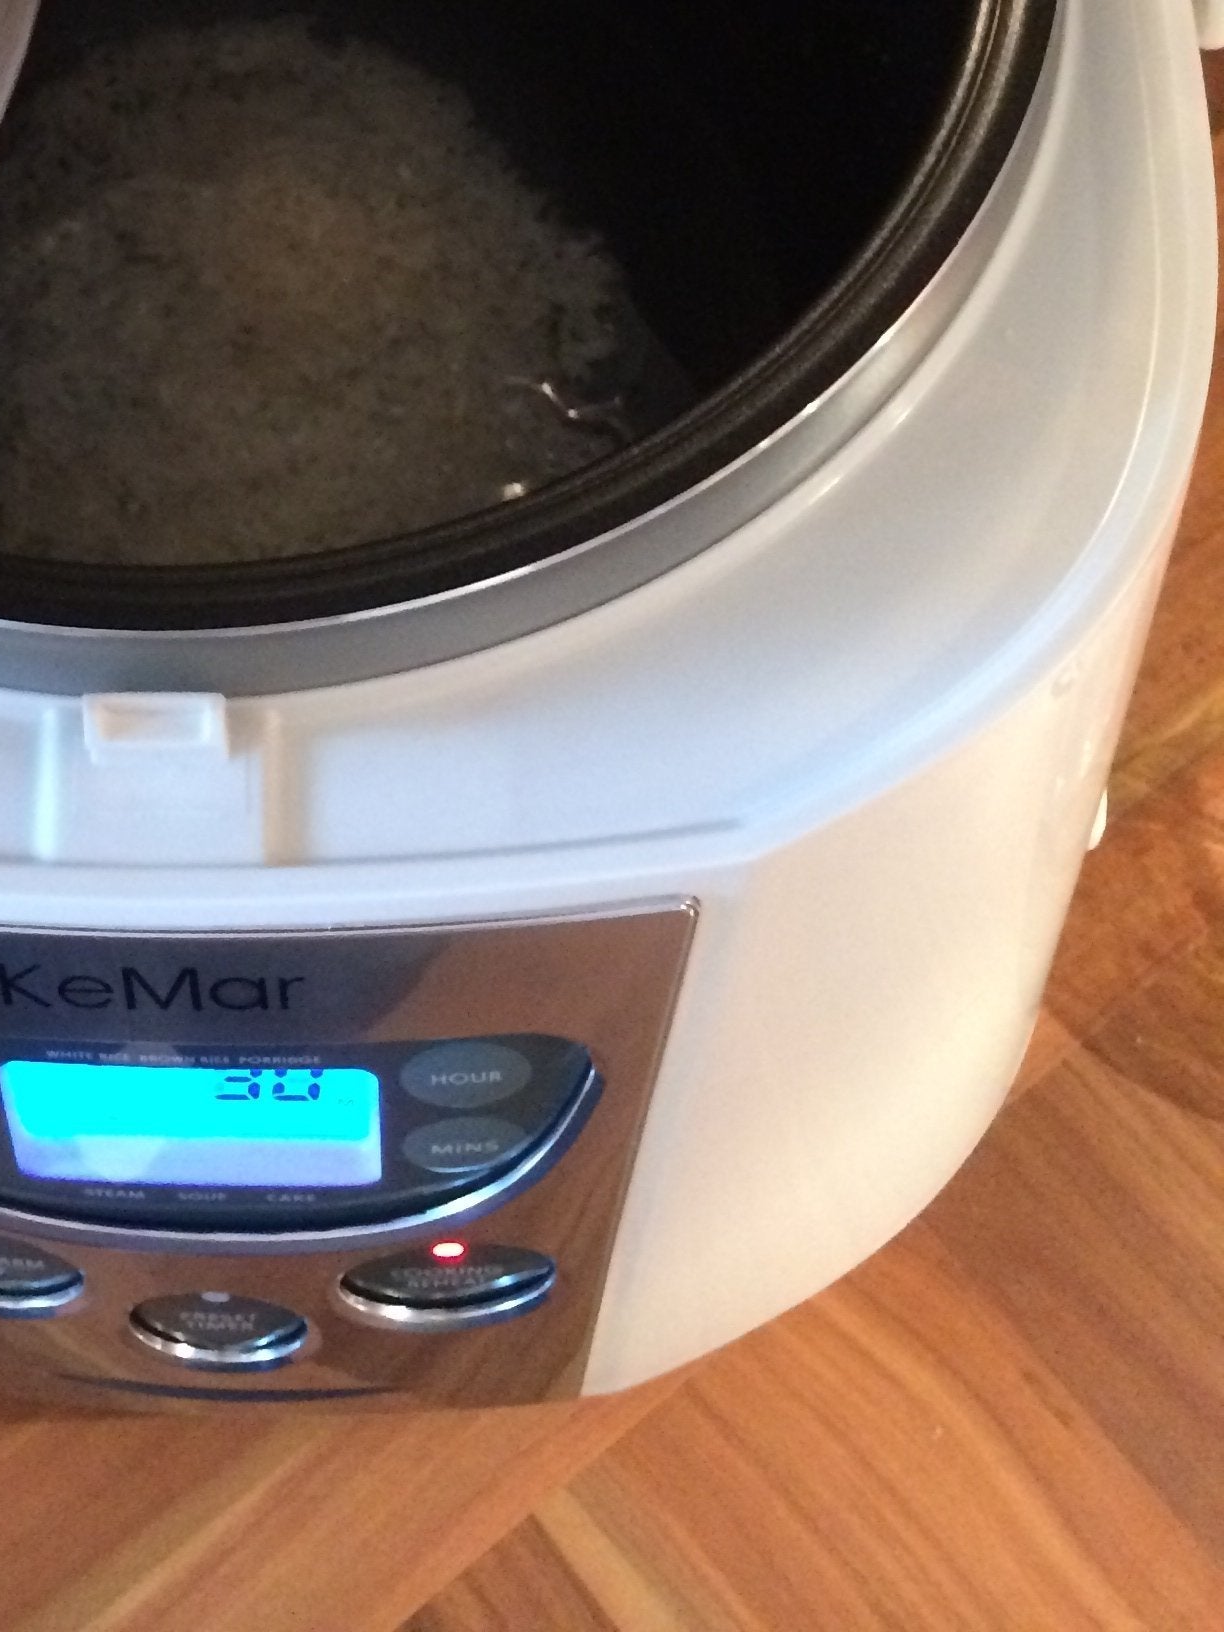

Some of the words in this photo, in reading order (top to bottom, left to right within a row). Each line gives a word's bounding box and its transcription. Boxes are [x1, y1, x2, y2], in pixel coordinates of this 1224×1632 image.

[431, 1072, 503, 1086] HOUR
[431, 1140, 499, 1154] MINS
[84, 1188, 145, 1200] STEAM
